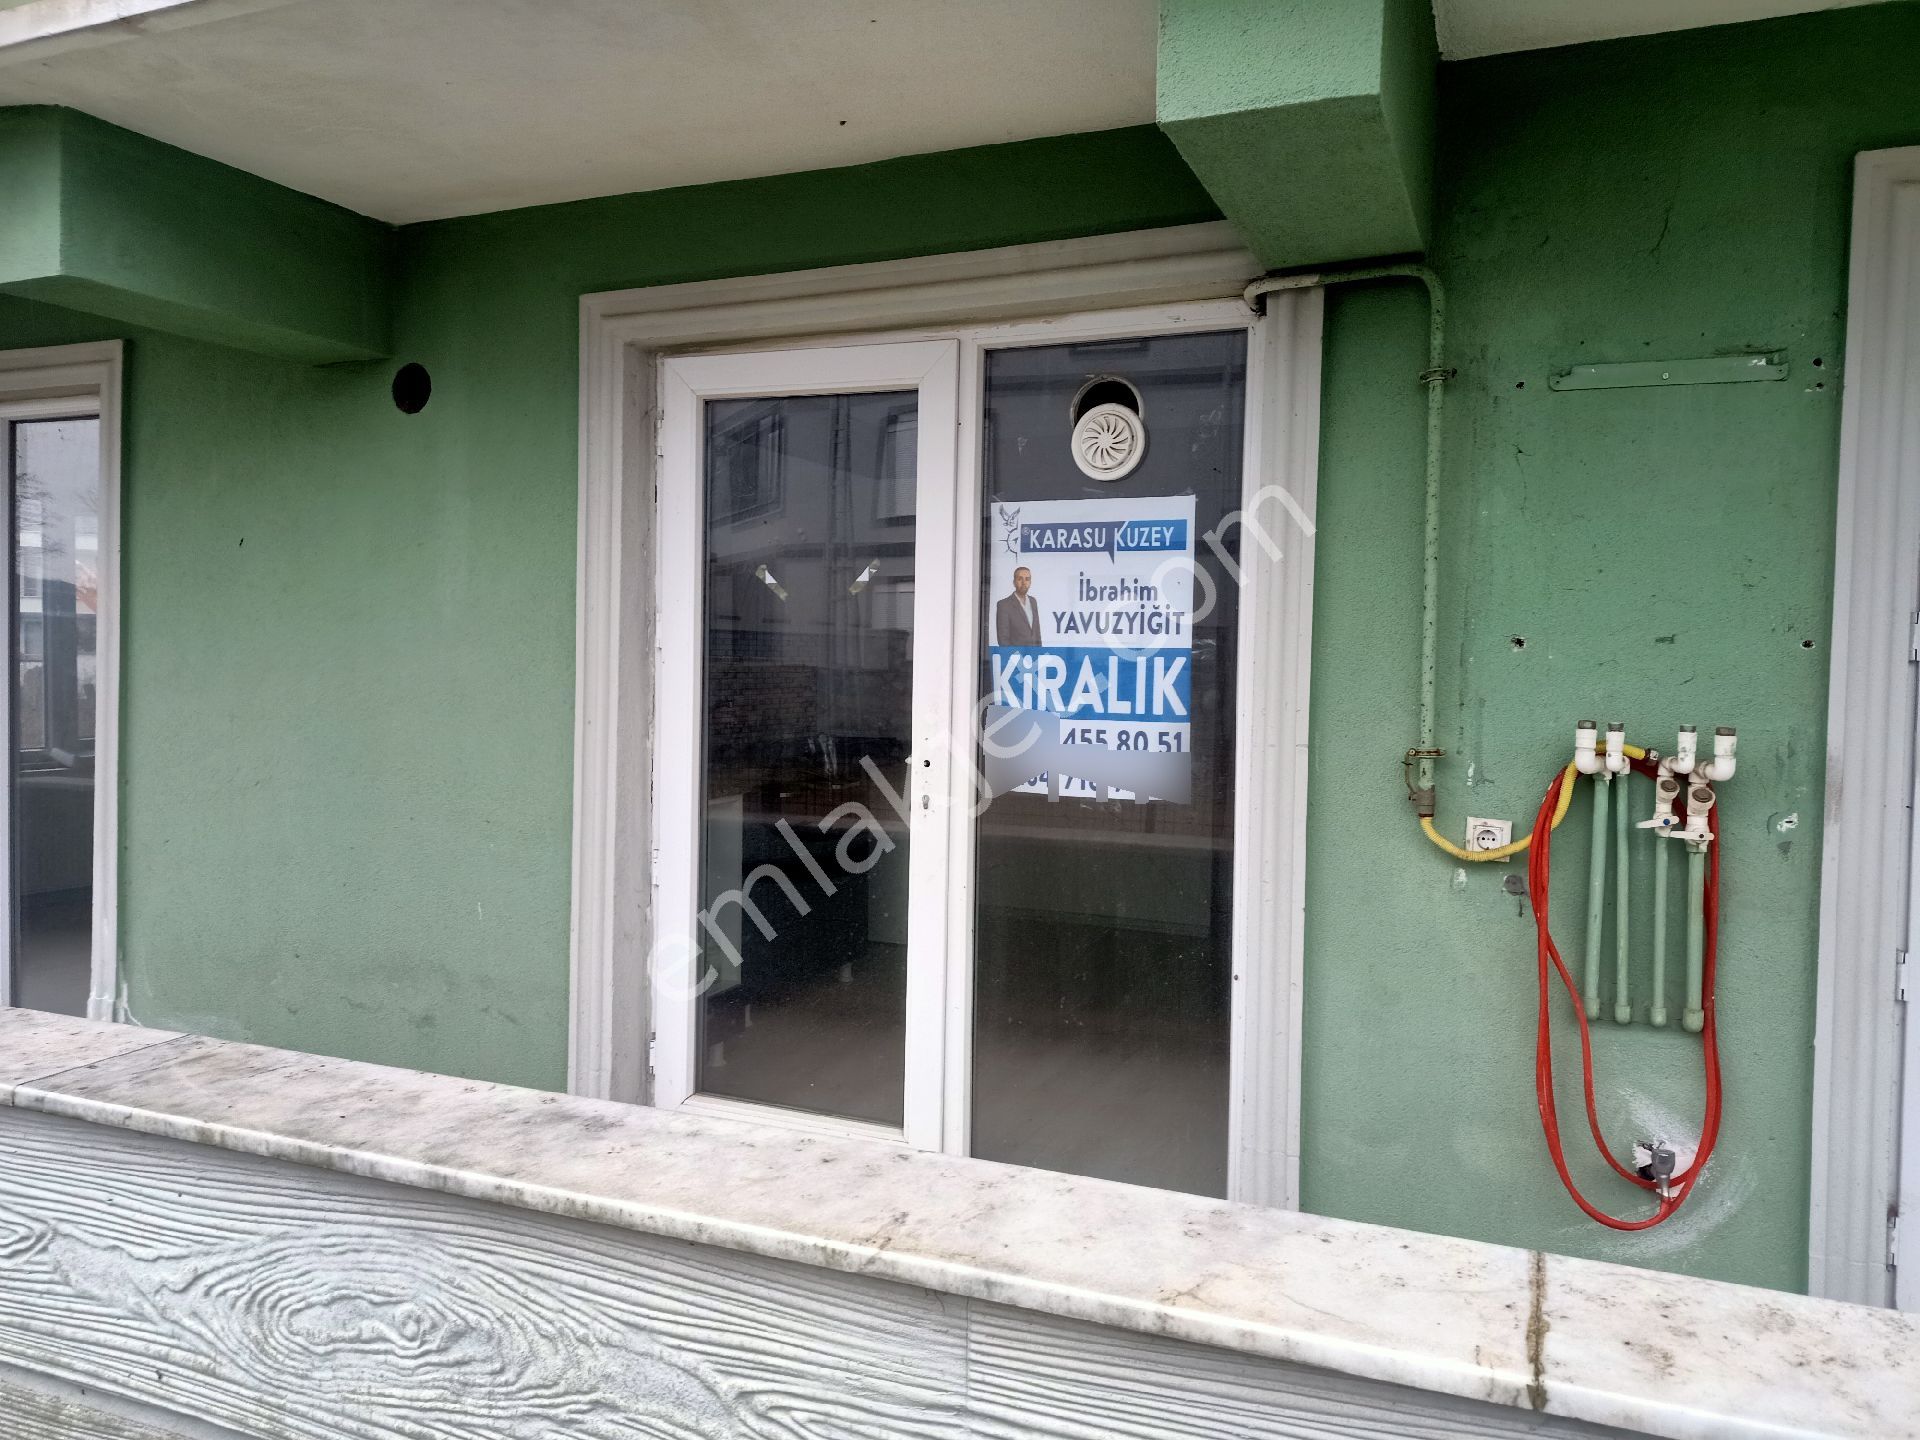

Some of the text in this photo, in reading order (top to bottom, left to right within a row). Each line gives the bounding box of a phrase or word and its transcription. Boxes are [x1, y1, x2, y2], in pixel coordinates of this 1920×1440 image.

[1029, 523, 1175, 549] KARASU KUZEY
[1079, 571, 1158, 602] İbrahim
[1052, 603, 1185, 635] YAVUZYİĞİT
